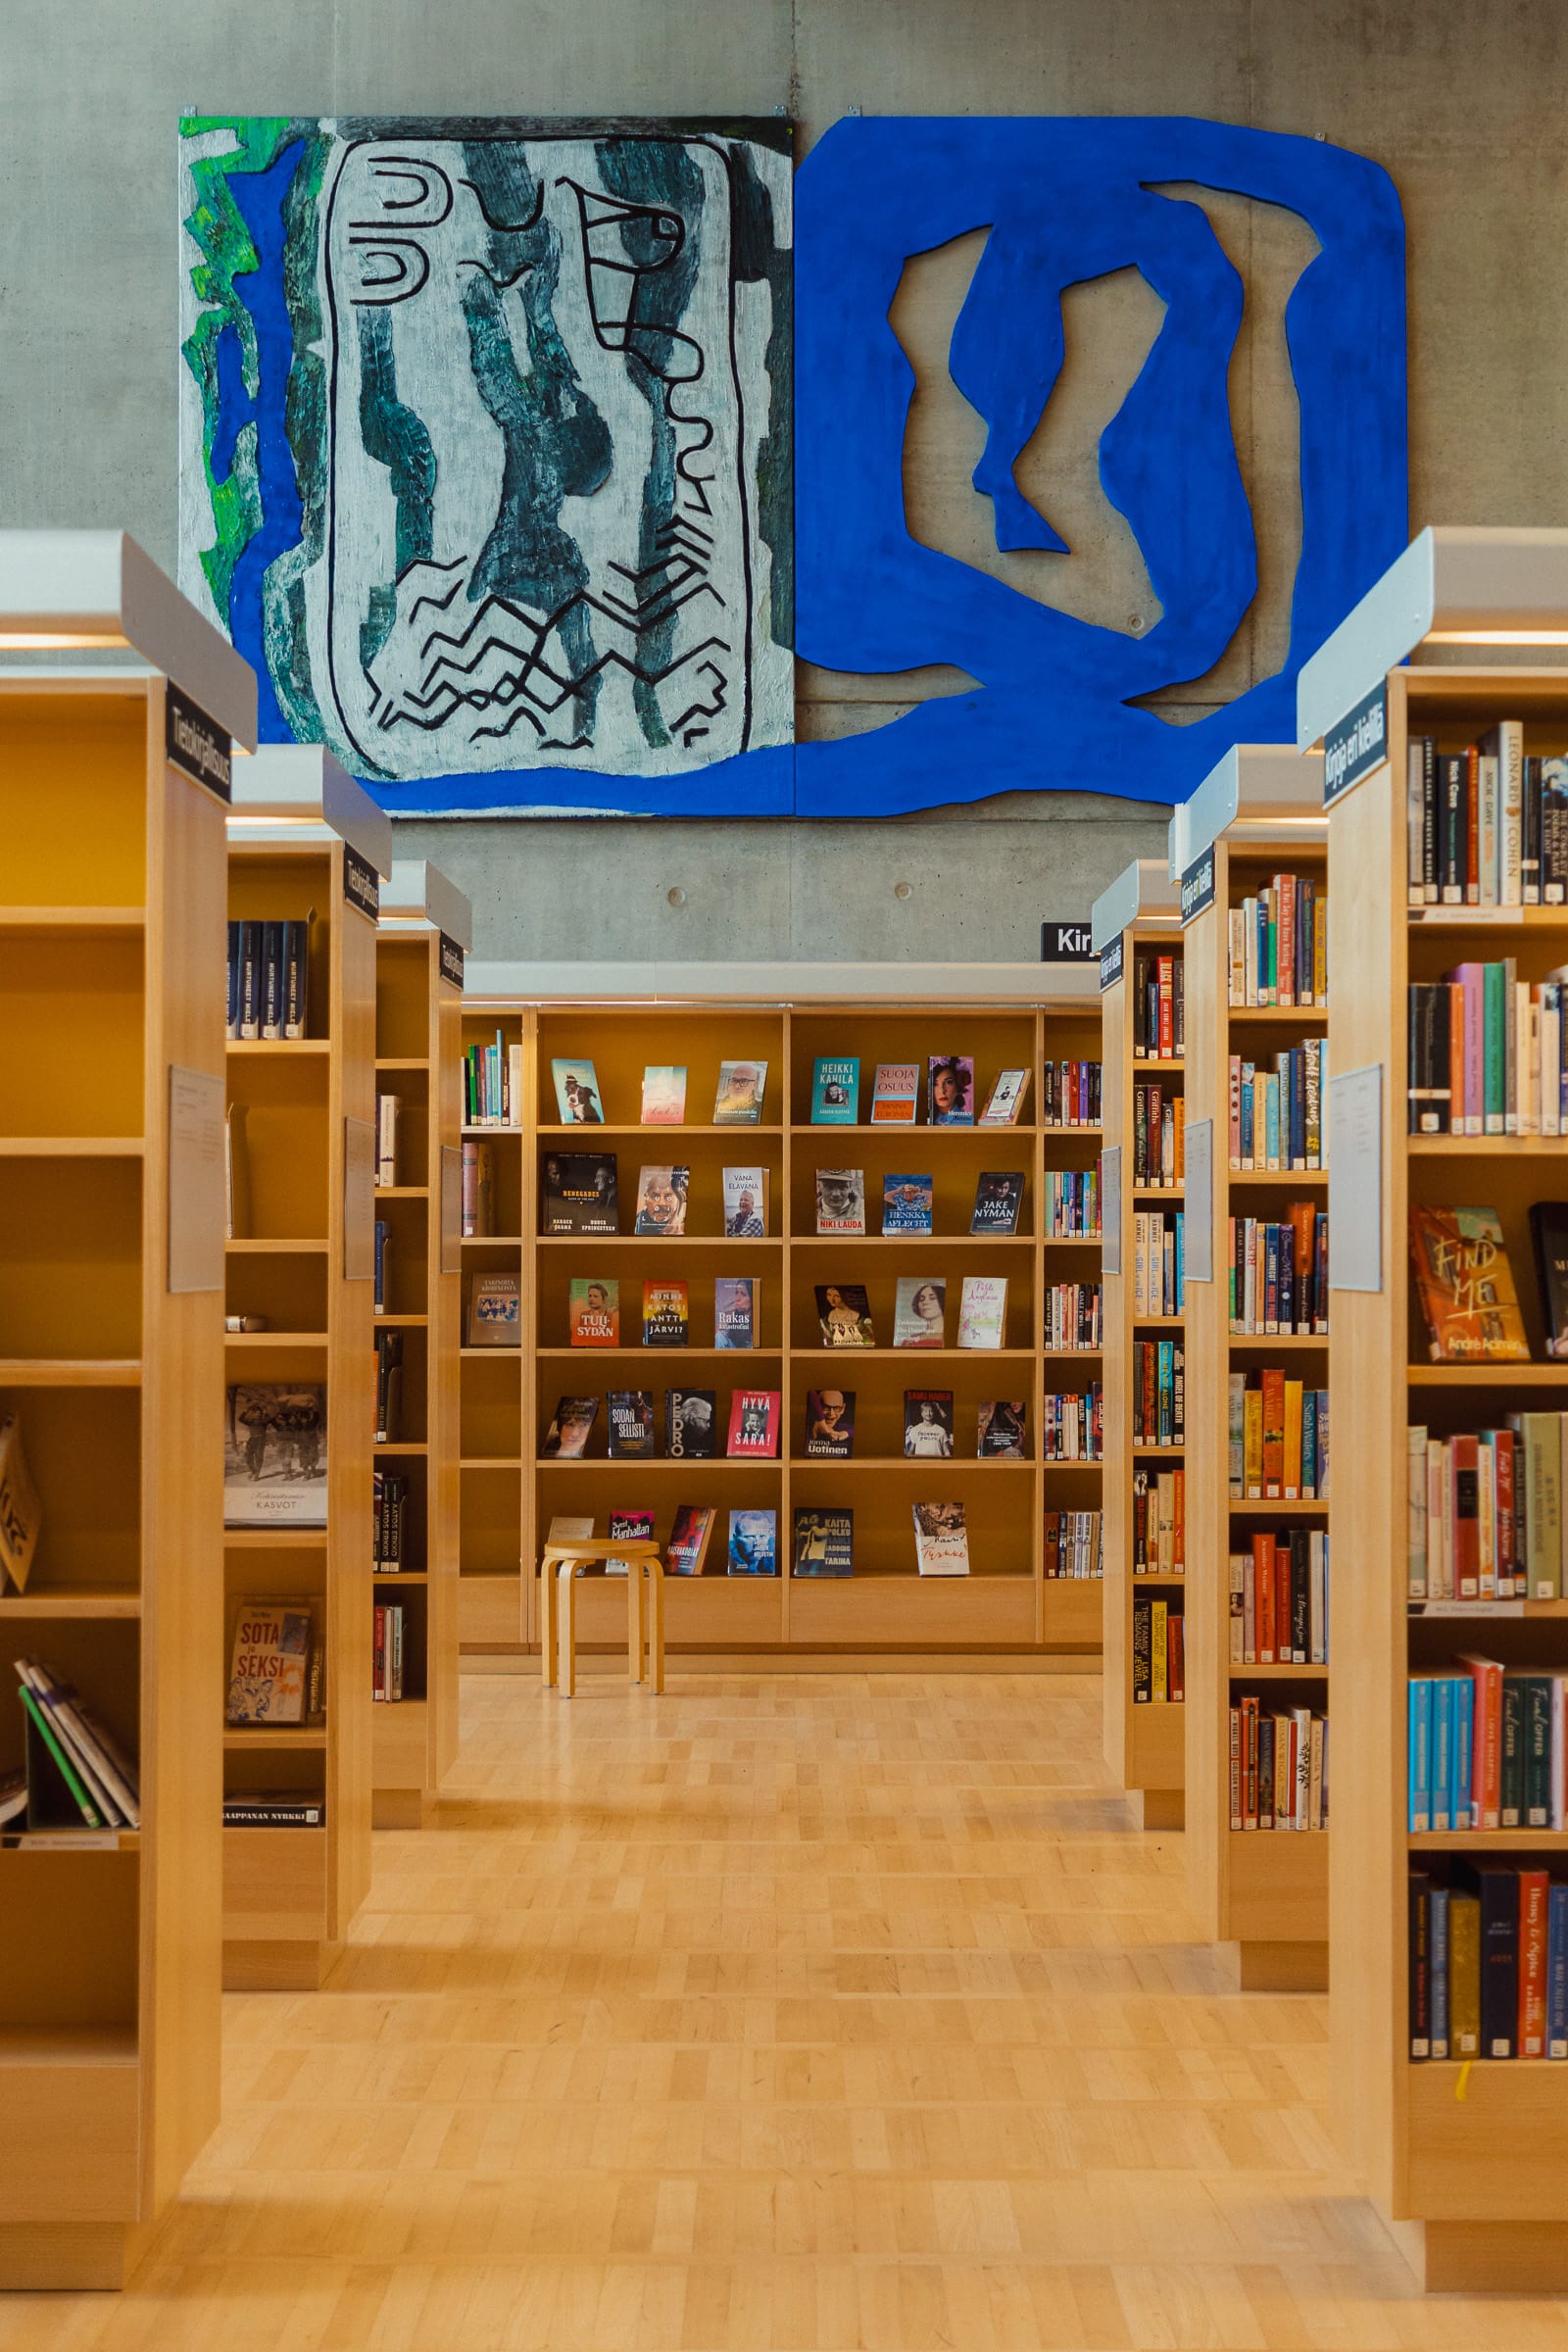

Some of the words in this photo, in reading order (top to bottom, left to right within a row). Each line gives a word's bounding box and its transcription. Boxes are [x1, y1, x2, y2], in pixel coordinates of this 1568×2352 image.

[1449, 760, 1459, 783] Nick
[1508, 736, 1519, 803] LEONARD
[1449, 784, 1459, 808] Cave
[1508, 827, 1519, 877] COHEN
[821, 1063, 854, 1074] HEIKKI
[880, 1069, 914, 1080] SUOJA
[819, 1074, 854, 1084] KAHILA
[877, 1082, 913, 1092] OSUUS
[983, 1200, 1008, 1209] JAKE
[974, 1208, 1014, 1218] NYMAN
[837, 1220, 862, 1229] LAUDA
[718, 1312, 750, 1323] Rakas
[576, 1324, 613, 1337] SYDÄN
[649, 1325, 683, 1334] JÄRVI?
[742, 1396, 770, 1410] HYVÄ
[612, 1408, 635, 1423] SODAN
[1303, 1402, 1314, 1429] Sarah
[618, 1423, 645, 1438] SELLISTI
[670, 1393, 684, 1457] PEDRO
[735, 1432, 771, 1446] SARA!
[1303, 1431, 1314, 1461] Waters
[808, 1445, 848, 1454] Uotinen
[256, 1500, 297, 1509] KASVOT
[824, 1518, 851, 1528] KAITA
[612, 1523, 650, 1541] Manhattan
[241, 1623, 279, 1644] SOTA
[237, 1655, 285, 1678] SEKSI
[1505, 1724, 1514, 1757] OFFER
[1534, 1723, 1544, 1756] OFFER
[1527, 1886, 1542, 1925] Honey
[1526, 1940, 1541, 1979] Spice
